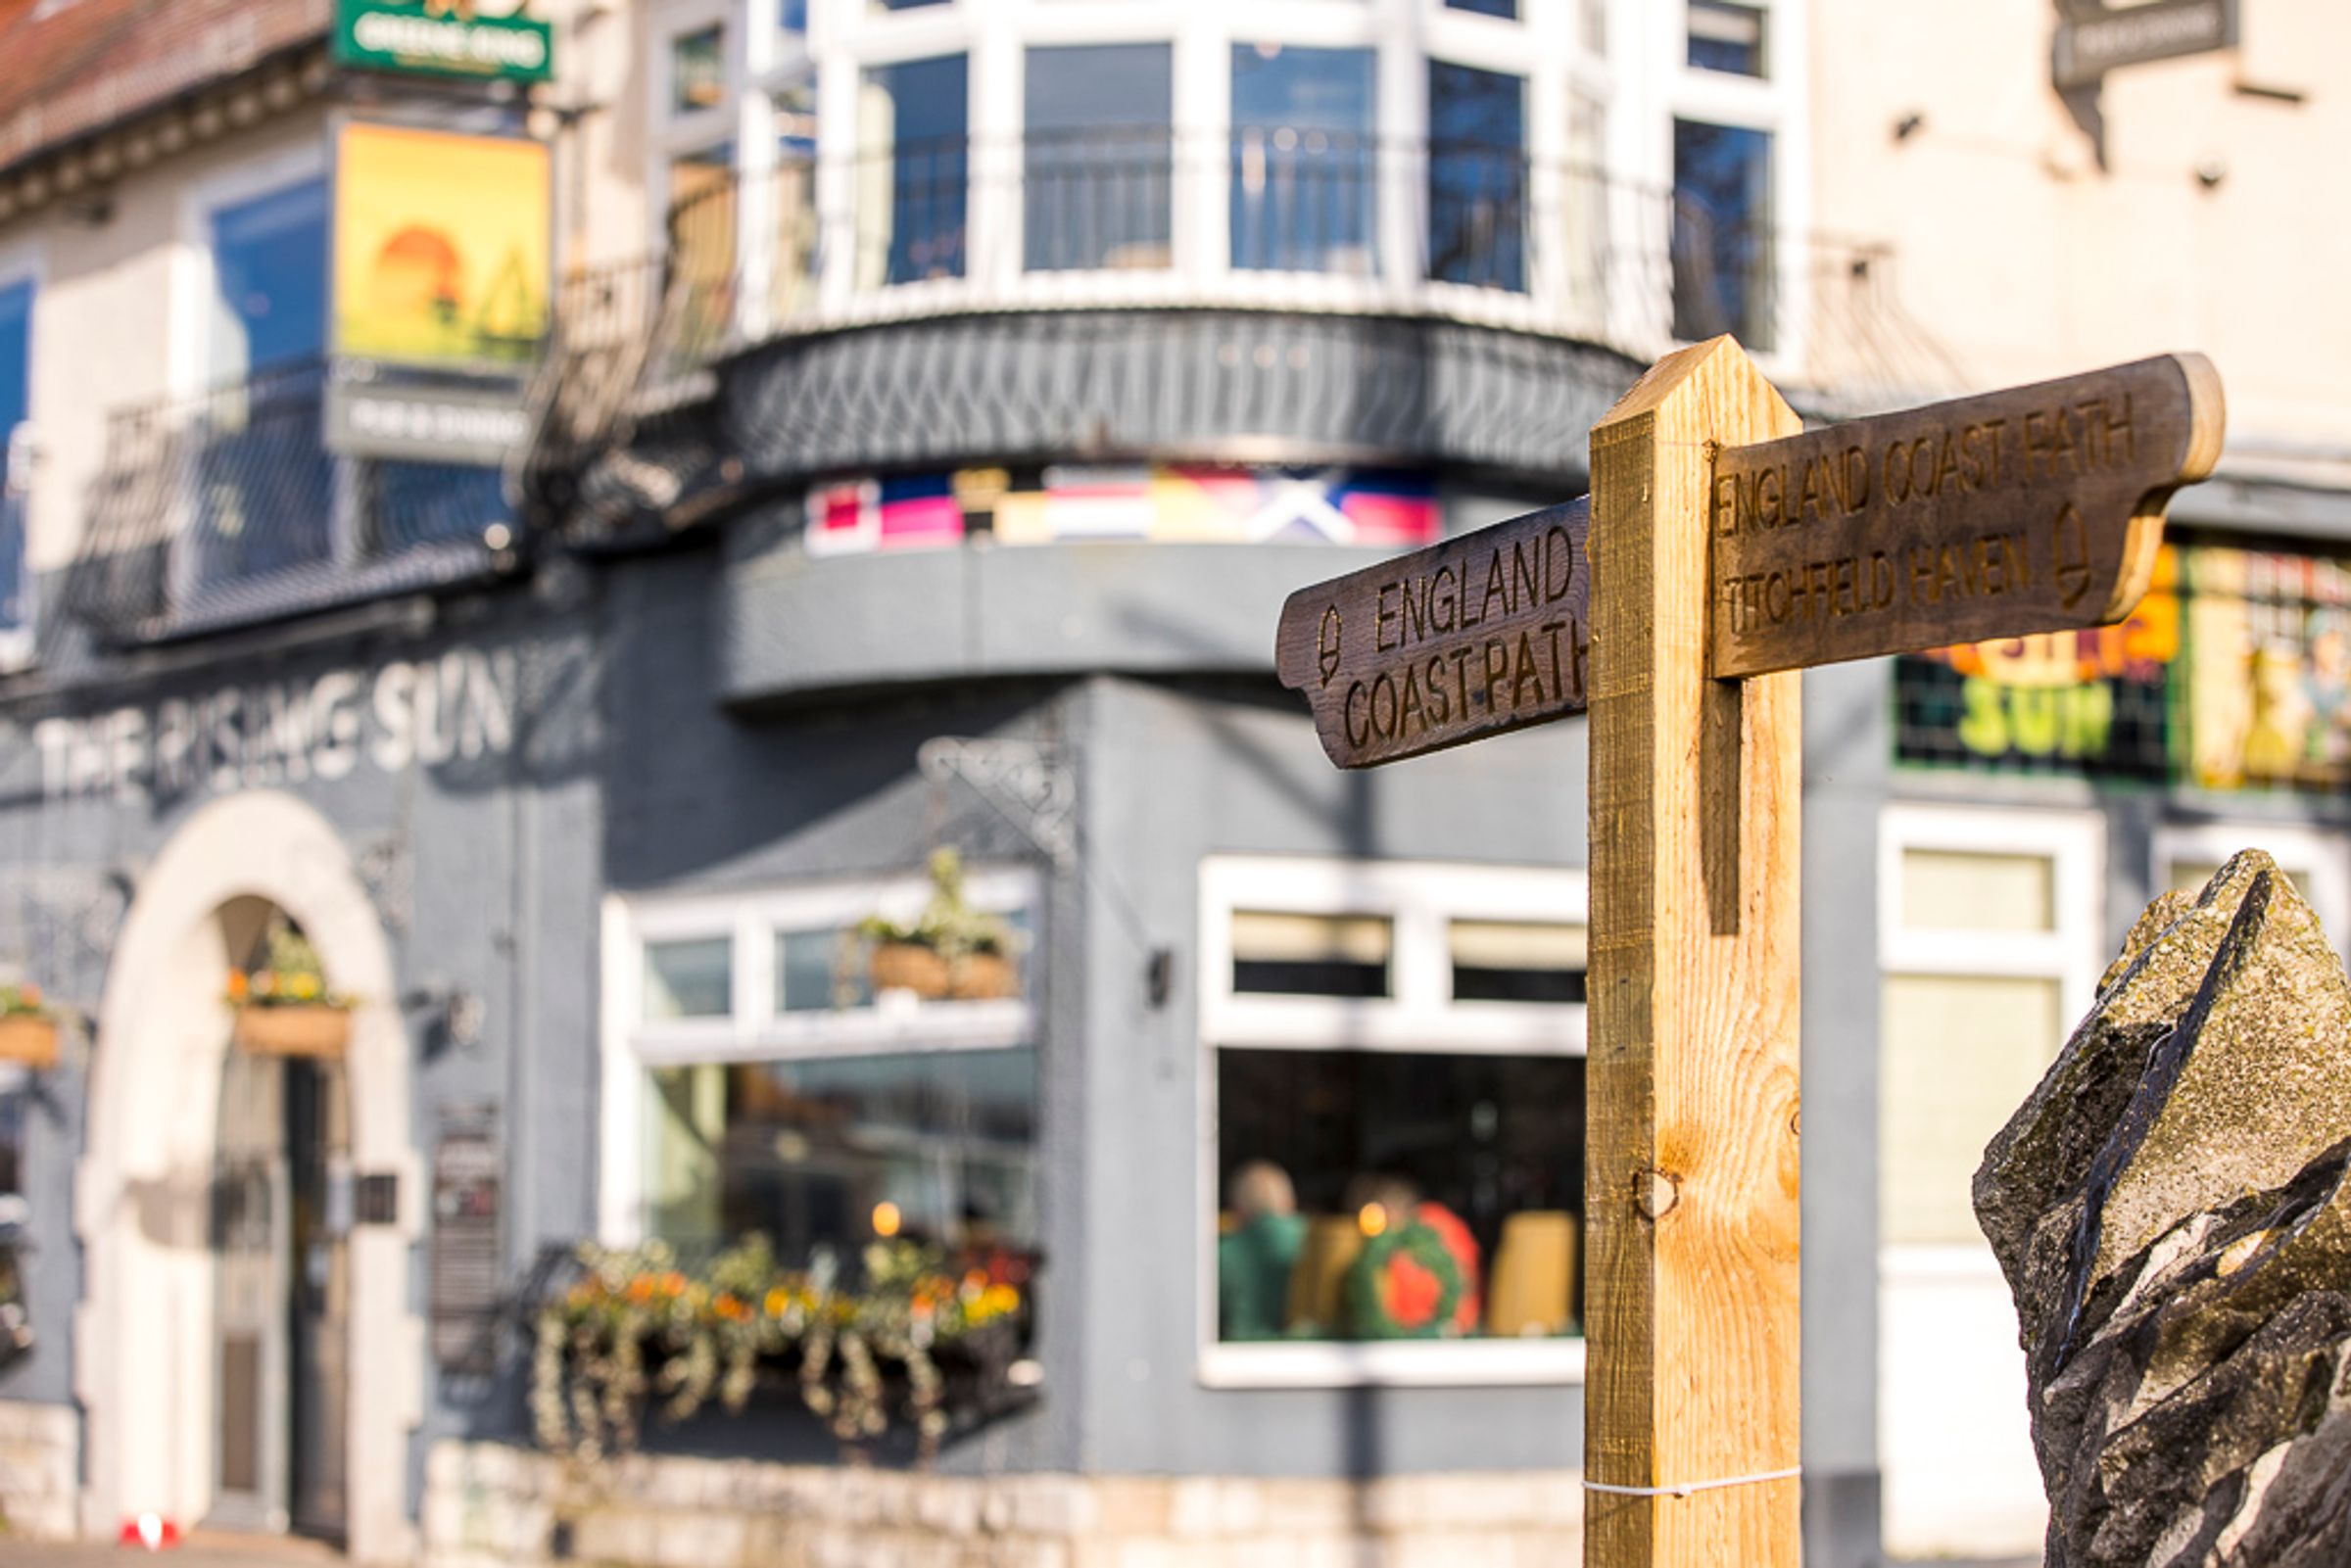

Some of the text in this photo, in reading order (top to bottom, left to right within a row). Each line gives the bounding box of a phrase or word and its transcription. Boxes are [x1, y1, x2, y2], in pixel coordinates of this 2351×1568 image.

[1716, 391, 2135, 536] ENGLAND COAST PATH
[1376, 525, 1572, 653] ENGLAND
[1909, 531, 2031, 605] HAVEN
[32, 706, 149, 805] THE
[371, 644, 511, 772] SUN
[1345, 645, 1473, 750] COAST
[1960, 678, 2113, 758] SUN
